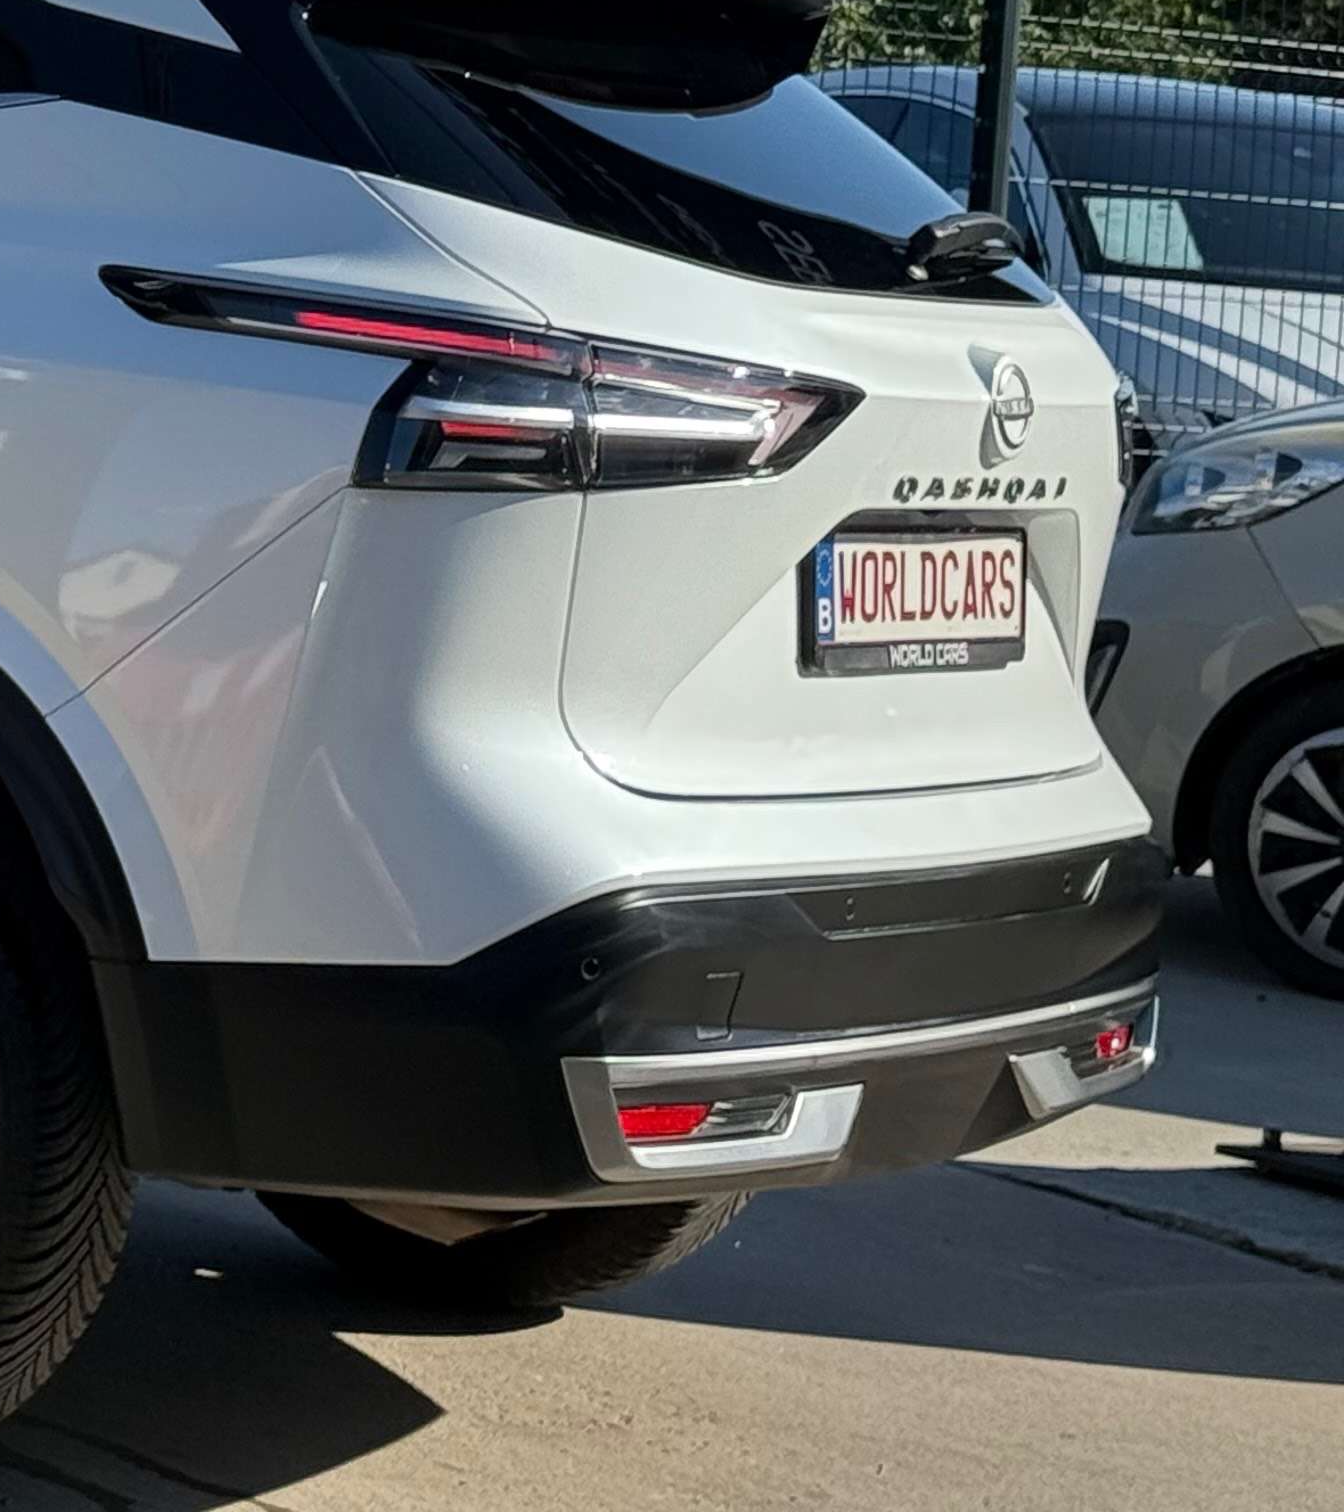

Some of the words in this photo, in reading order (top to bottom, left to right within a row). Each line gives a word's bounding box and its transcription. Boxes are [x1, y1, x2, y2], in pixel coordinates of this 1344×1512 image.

[892, 475, 1068, 504] QASHQAI
[817, 598, 833, 634] B
[838, 549, 1016, 625] WORLDCARS
[889, 644, 934, 669] WORLD
[935, 642, 969, 666] CARS
